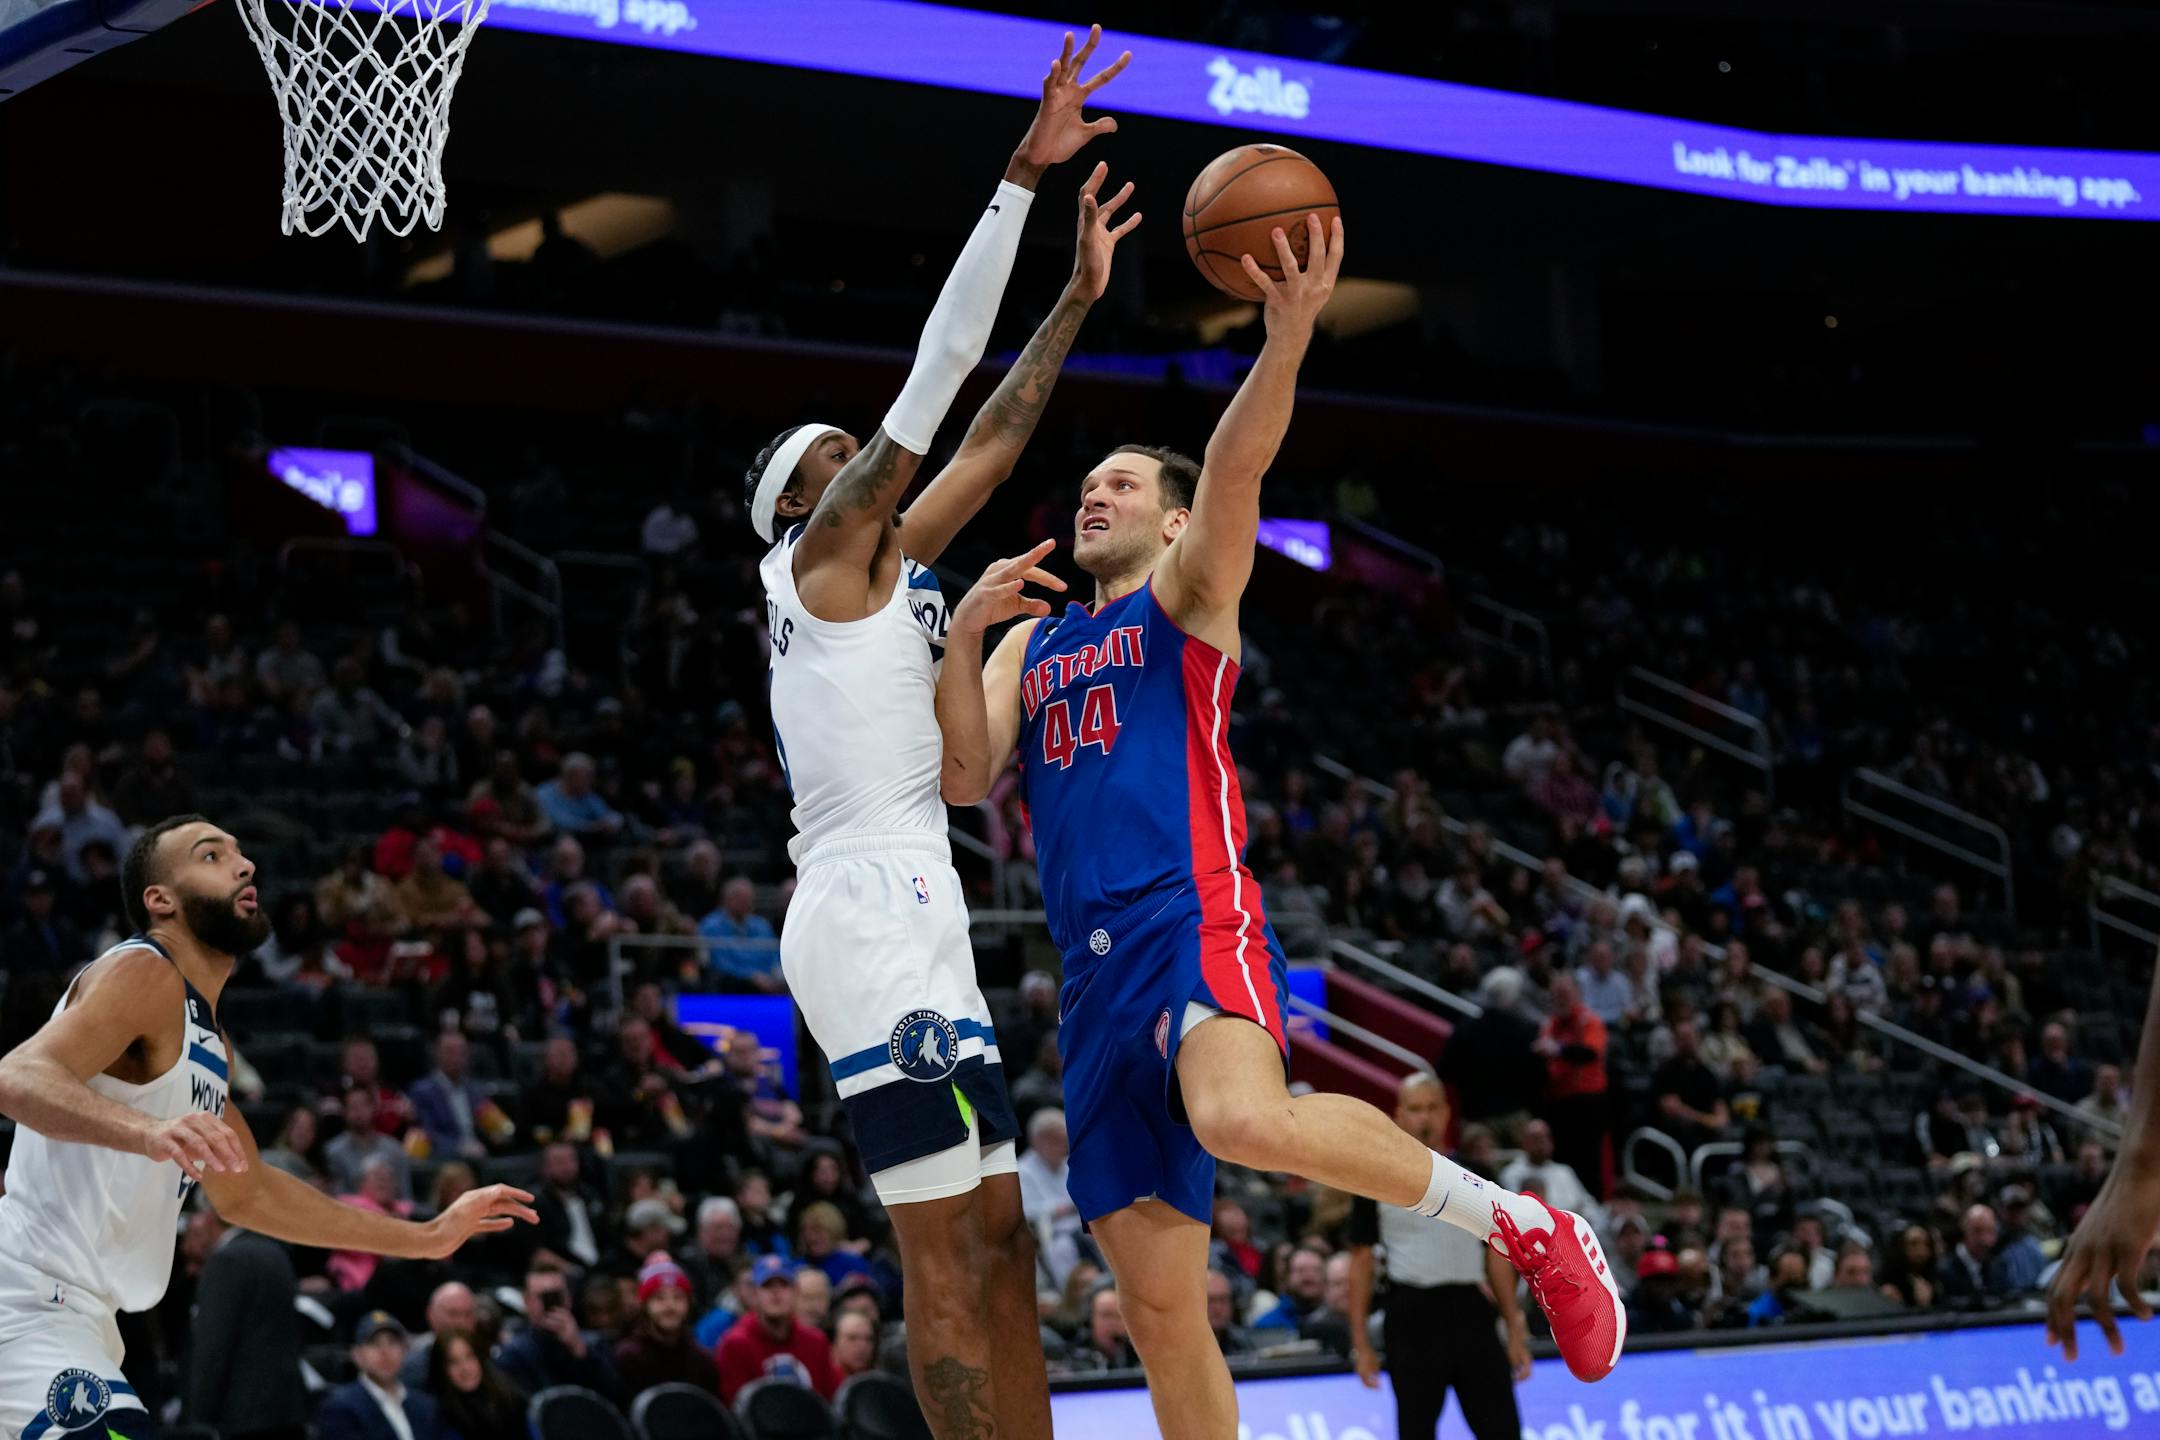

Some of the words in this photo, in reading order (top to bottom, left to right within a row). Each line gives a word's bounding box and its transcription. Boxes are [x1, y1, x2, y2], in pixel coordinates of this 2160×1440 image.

[1206, 55, 1311, 119] Zelle
[1673, 140, 1735, 181] Look
[1736, 150, 1772, 185] for
[1858, 159, 1891, 192] in
[1892, 168, 1959, 201] your
[1961, 163, 2078, 207] banking
[2080, 176, 2142, 209] app.
[1021, 624, 1145, 723] DETROIT
[1042, 682, 1122, 771] 44
[892, 1015, 914, 1066] MINNESOTA
[1620, 1399, 1699, 1440] for
[1703, 1392, 1748, 1440] it
[1752, 1388, 1813, 1440] in
[1814, 1392, 1929, 1440] your
[1930, 1364, 2130, 1432] banking
[2129, 1370, 2160, 1413] a
